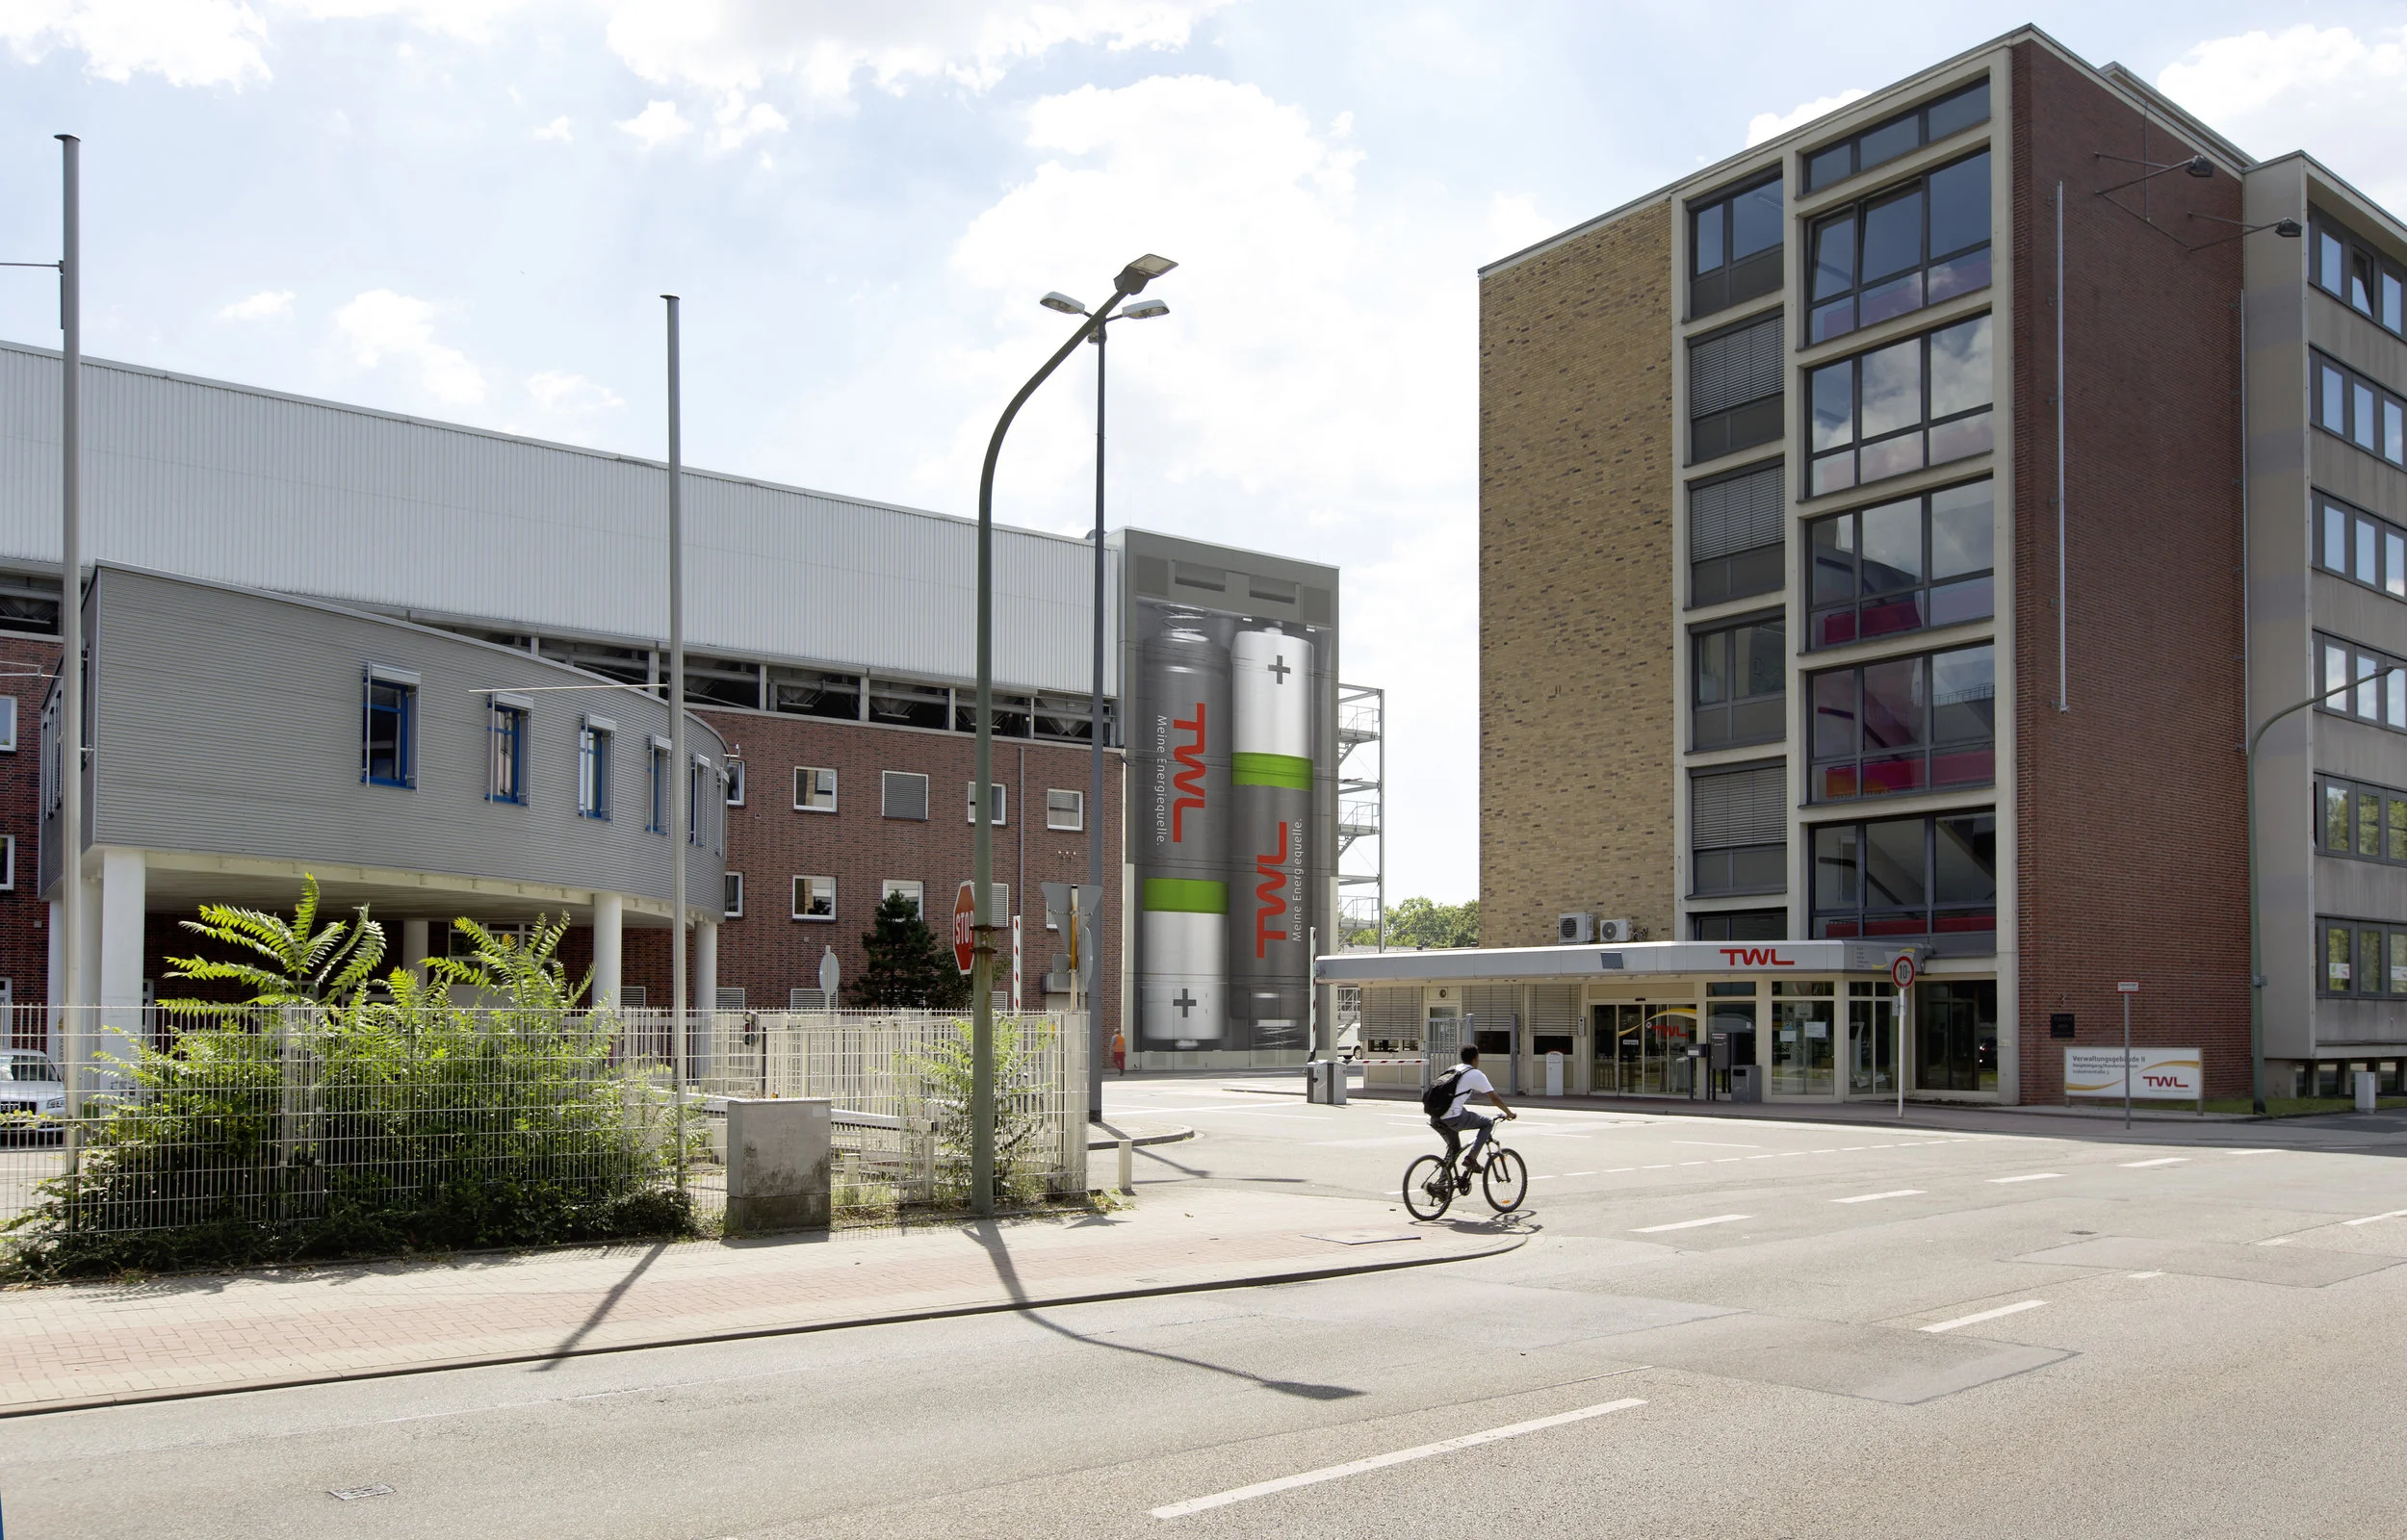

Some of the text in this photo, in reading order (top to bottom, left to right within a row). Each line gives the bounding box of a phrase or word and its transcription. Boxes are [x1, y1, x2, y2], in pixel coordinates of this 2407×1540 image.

[1154, 714, 1168, 846] Meine Energiequelle.
[1173, 703, 1205, 843] TWL
[1255, 821, 1287, 959] TWL
[956, 911, 974, 944] STOP
[1292, 906, 1303, 942] Meine
[1720, 948, 1796, 966] TWL
[1900, 964, 1907, 979] 10
[1652, 1025, 1689, 1037] TWL
[2142, 1076, 2189, 1088] TWL
